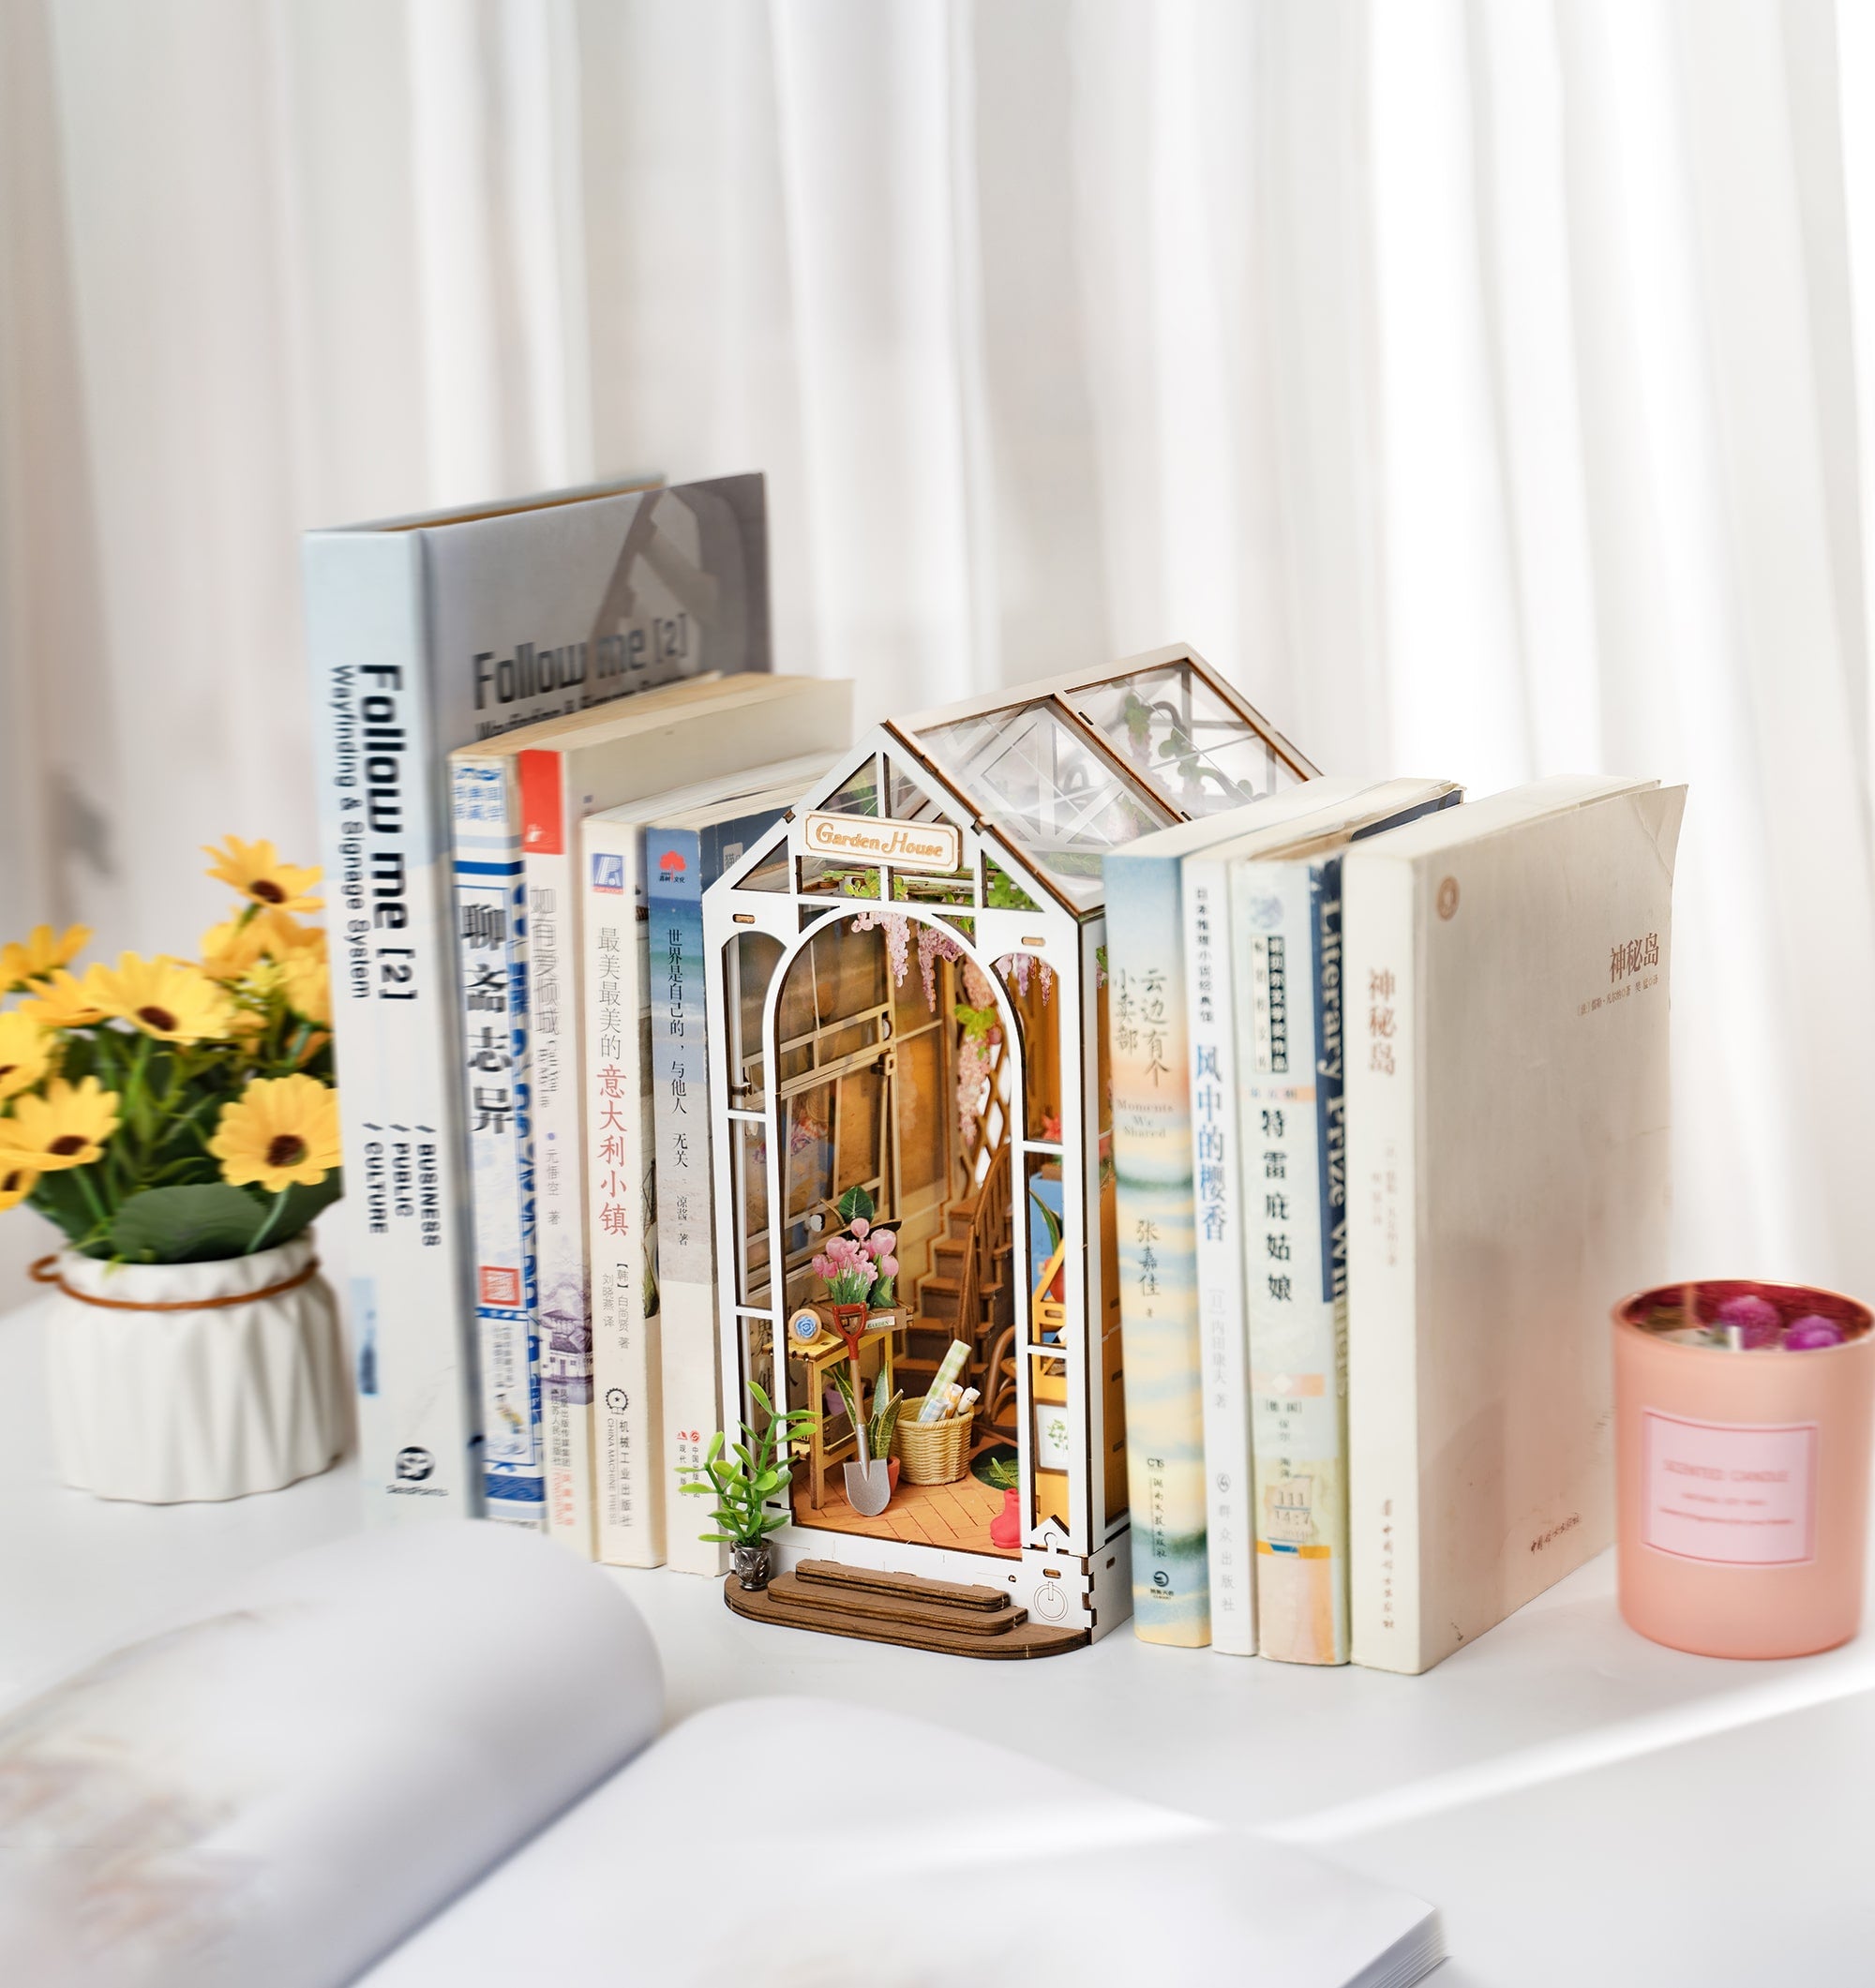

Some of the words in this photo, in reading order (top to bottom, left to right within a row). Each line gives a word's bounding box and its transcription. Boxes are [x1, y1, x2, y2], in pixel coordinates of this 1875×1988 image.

[473, 642, 587, 710] Follow
[596, 629, 646, 680] me
[652, 613, 688, 664] [2]
[328, 665, 359, 787] Wayfinding
[359, 665, 407, 832] Follow
[338, 821, 366, 909] Signage
[816, 822, 880, 851] Garden
[881, 830, 944, 859] House
[369, 852, 409, 929] me
[343, 919, 372, 997] System
[375, 949, 417, 999] [2]
[1316, 900, 1342, 1080] Literary
[1609, 933, 1659, 983] 神秘岛
[459, 904, 515, 1135] 聊斋志异
[667, 929, 687, 1114] 世界是自己的，与他人
[1115, 969, 1138, 1056] 小卖部
[1140, 968, 1170, 1088] 云边有个
[596, 927, 629, 1236] 最美最美的意大利小镇
[1117, 1099, 1174, 1114] Moments
[1132, 1114, 1155, 1127] We
[672, 1132, 688, 1168] 无关
[1124, 1126, 1166, 1140] Shared
[1196, 1045, 1226, 1242] 风中的樱香
[363, 1141, 388, 1233] CULTURE
[391, 1142, 414, 1217] PUBLIC
[416, 1143, 442, 1247] BUSINESS
[1136, 1218, 1161, 1297] 张嘉佳
[607, 1417, 617, 1447] CHINA
